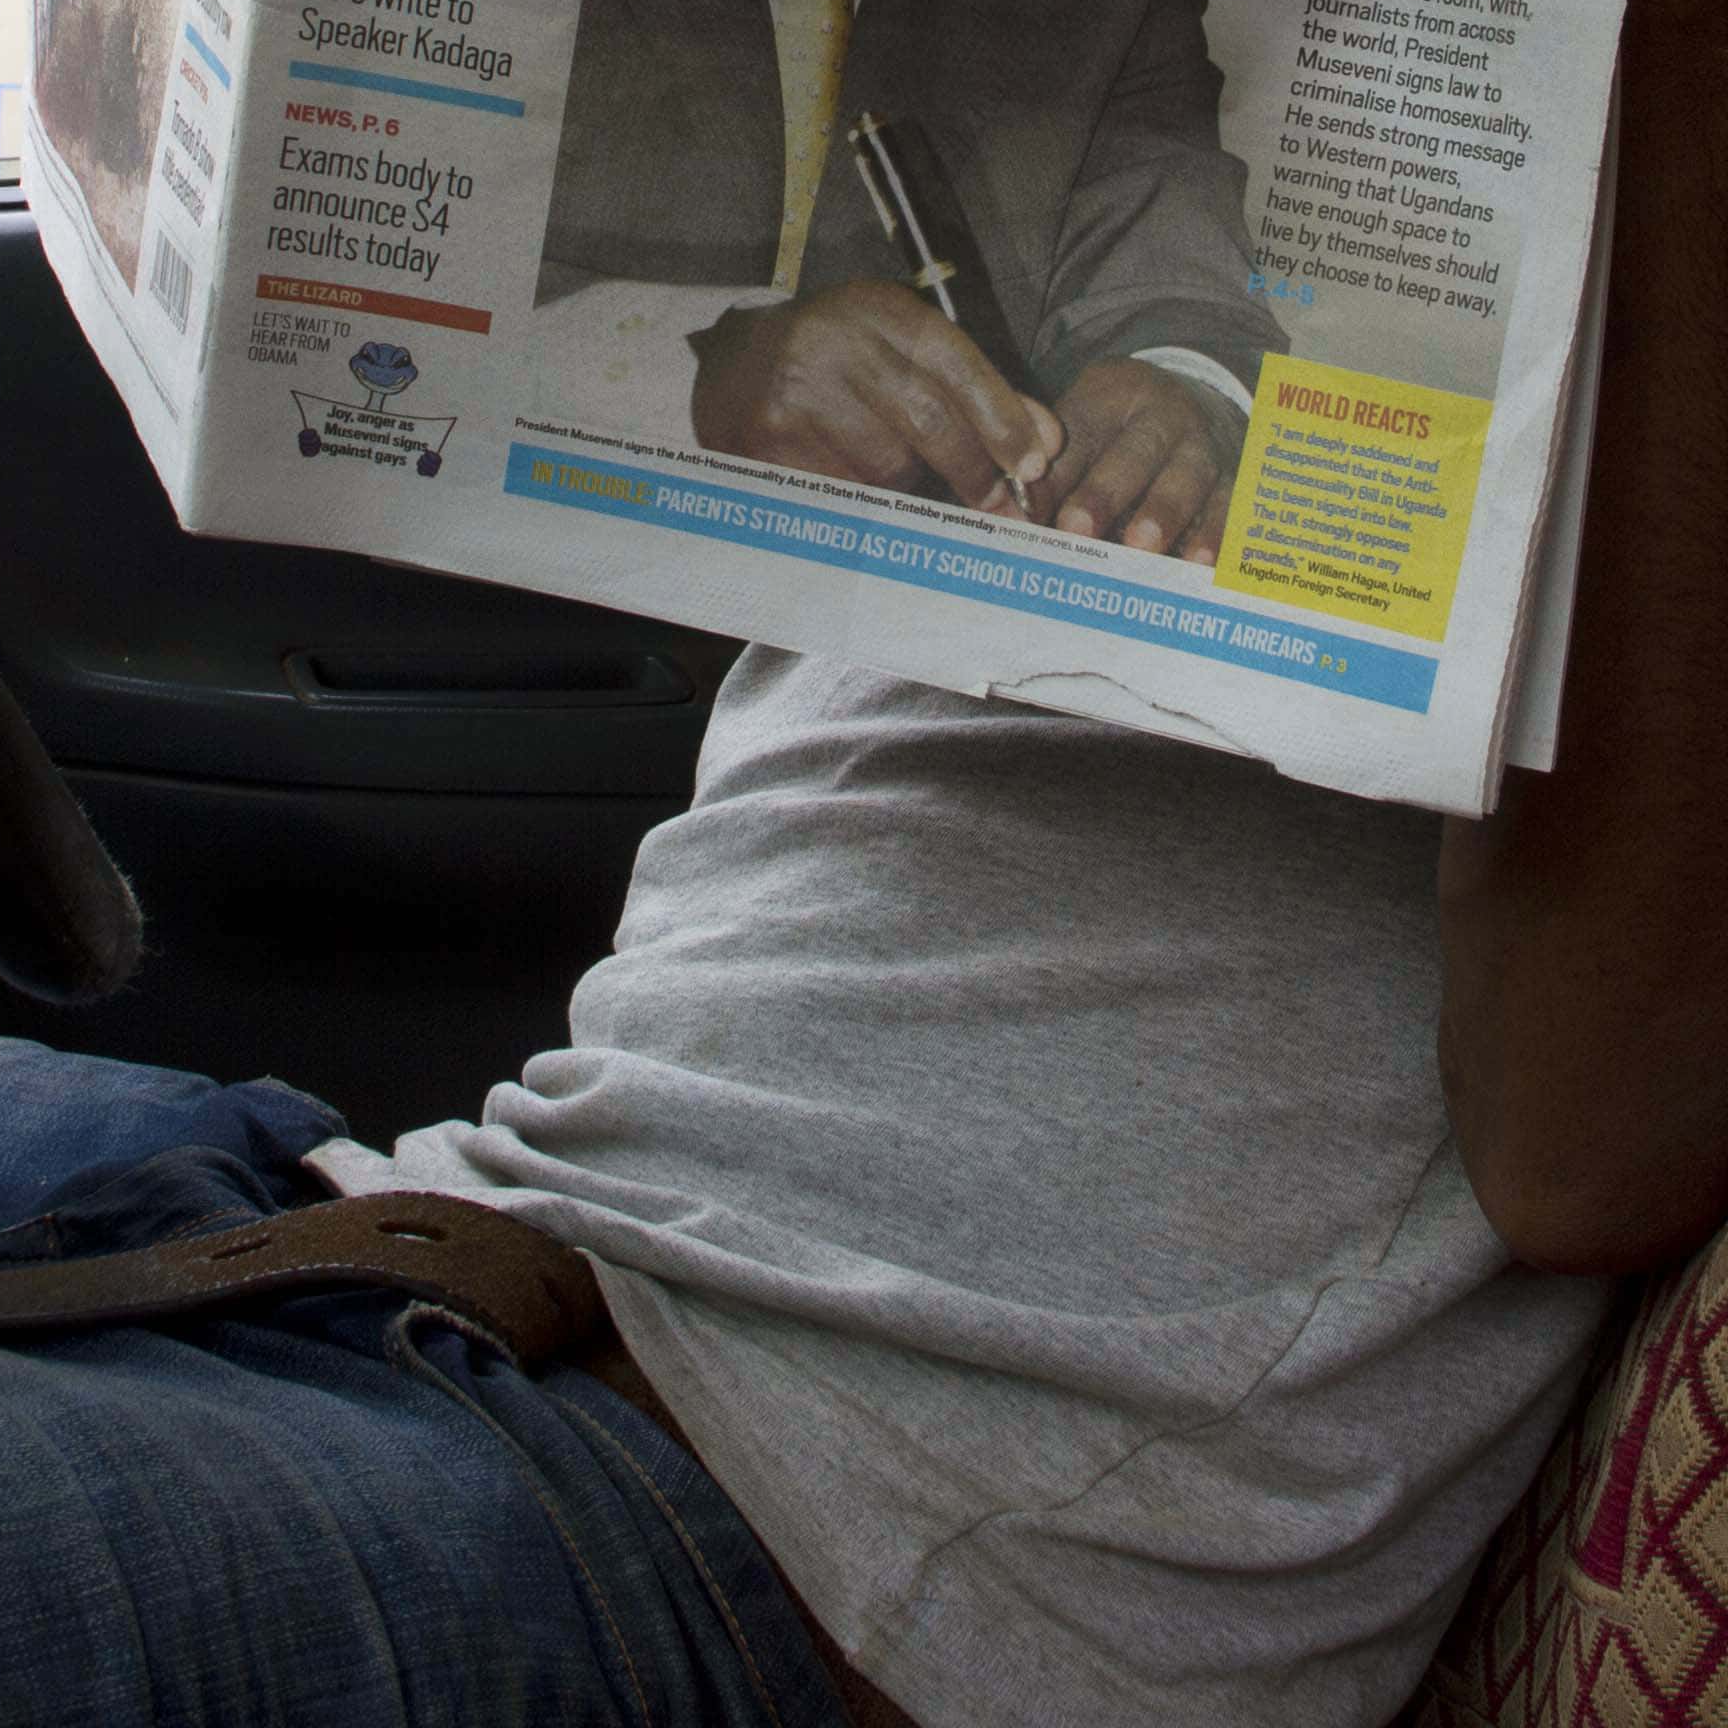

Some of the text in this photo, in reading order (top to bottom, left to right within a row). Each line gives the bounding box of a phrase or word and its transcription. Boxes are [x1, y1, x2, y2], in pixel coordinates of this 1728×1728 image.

[298, 6, 512, 81] Speaker Kadaga
[1302, 19, 1488, 70] the world, President
[1414, 8, 1454, 35] from
[1458, 22, 1515, 44] across
[1296, 46, 1501, 103] Museveni signs law to
[284, 102, 401, 135] NEWS, P. 6
[1290, 79, 1532, 142] criminalise homosexuality.
[279, 135, 472, 205] Exams body to
[273, 186, 449, 236] announce S4
[267, 226, 440, 281] results today
[267, 279, 363, 305] THE LIZARD
[250, 329, 330, 351] HEAR FROM
[253, 311, 351, 337] LET'S WAIT TO
[247, 345, 298, 365] OBAMA
[324, 421, 430, 451] Museveni signs
[1274, 382, 1432, 440] WORLD REACTS
[320, 441, 407, 466] against gays
[514, 416, 567, 438] President
[569, 428, 624, 450] Museveni
[623, 442, 653, 457] signs
[654, 447, 674, 461] the
[676, 451, 784, 488] Anti-Homosexuality
[786, 475, 807, 490] Act
[808, 482, 822, 493] at
[821, 482, 853, 500] State
[854, 490, 892, 510] House,
[893, 498, 940, 519] Entebbe
[530, 459, 1319, 664] IN TROUBLE: PARENTS STRANDED AS CITY SCHOOL IS CLOSED OVER RENT ARREARS
